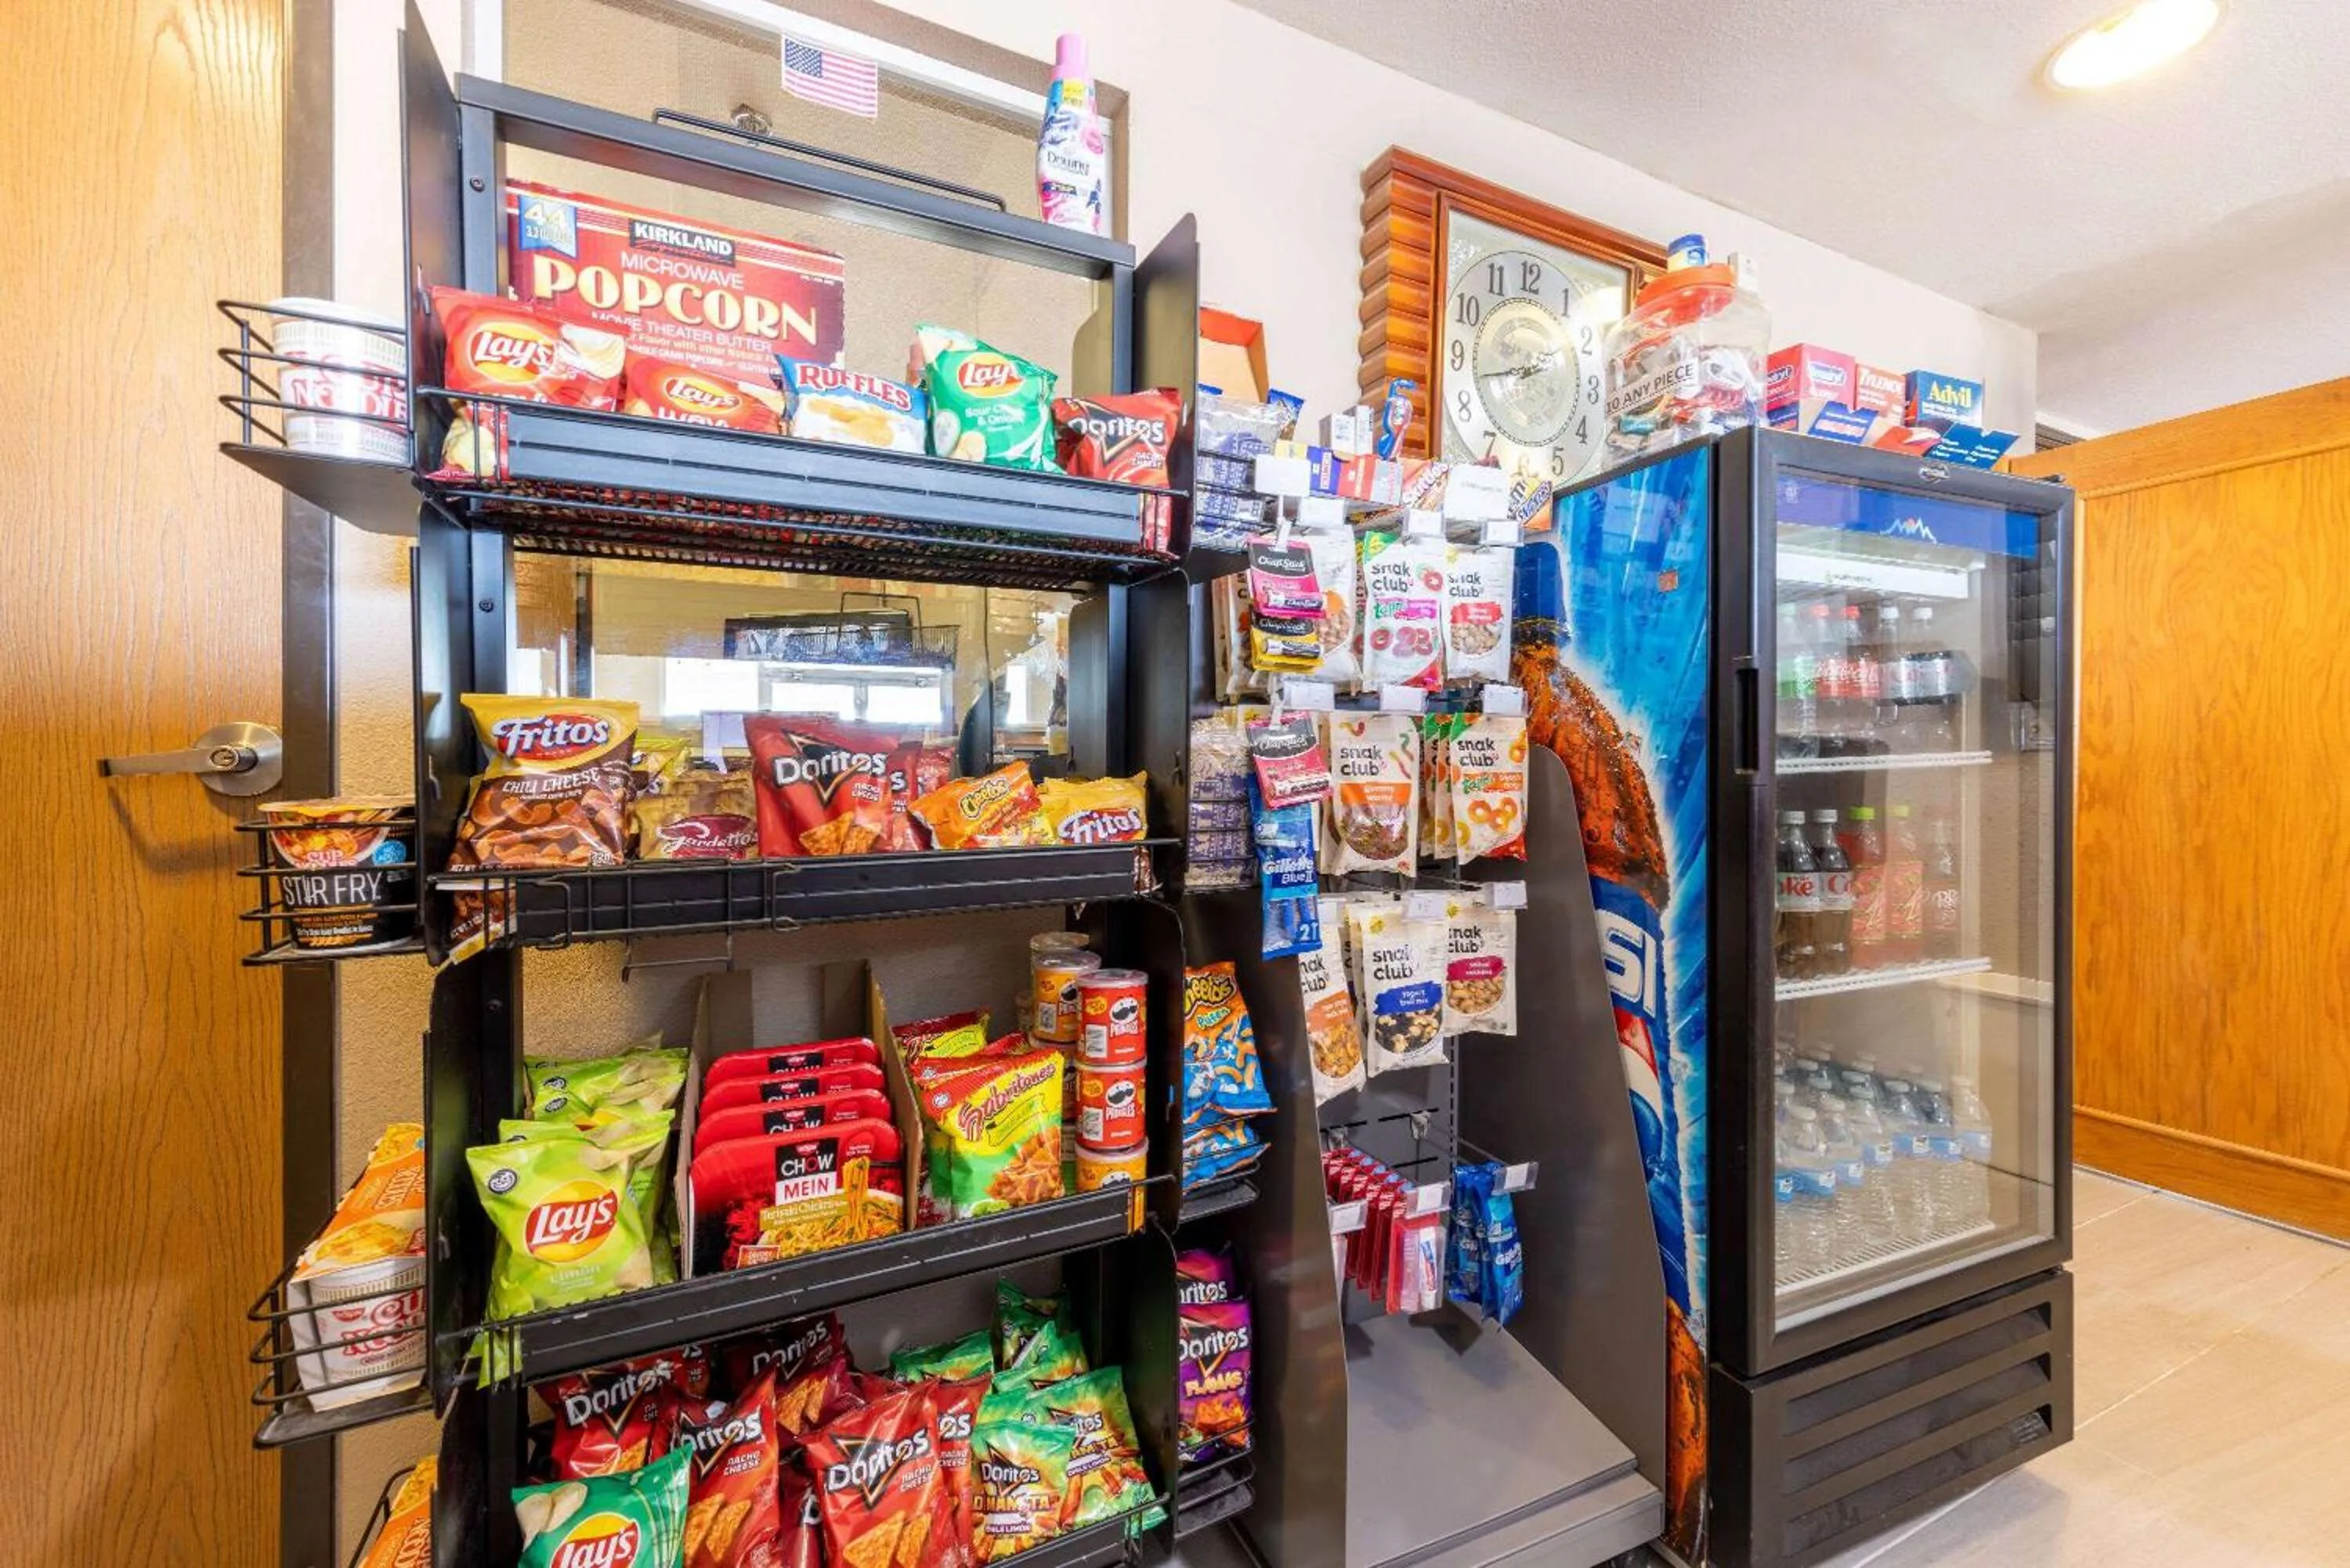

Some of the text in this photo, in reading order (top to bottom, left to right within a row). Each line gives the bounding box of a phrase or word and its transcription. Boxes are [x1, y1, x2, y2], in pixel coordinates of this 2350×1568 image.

[1047, 151, 1090, 176] Downy
[634, 222, 733, 256] KIRKLAND
[620, 251, 745, 291] MICROWAVE
[1488, 262, 1504, 297] 11
[1520, 260, 1541, 295] 12
[532, 254, 818, 346] POPCORN
[1455, 292, 1480, 327] 10
[1562, 287, 1571, 318] 1
[474, 331, 555, 368] Lay's
[645, 320, 714, 343] THEATER
[716, 332, 773, 354] BUTTER
[1581, 326, 1593, 356] 2
[1451, 338, 1464, 371] 9
[796, 360, 912, 410] RUFFLES
[963, 363, 1011, 388] Lay
[1587, 375, 1599, 405] 3
[1623, 381, 1651, 405] ANY
[1654, 363, 1694, 390] PIECE
[668, 378, 737, 408] Lay's
[1458, 389, 1472, 422] 8
[1929, 380, 1972, 408] Advil
[1068, 417, 1165, 443] Doritos
[1483, 430, 1497, 457] 7
[1575, 415, 1588, 445] 4
[1551, 446, 1564, 477] 5
[1257, 555, 1306, 569] ChapStick
[1371, 560, 1411, 576] snak
[1372, 576, 1409, 593] club
[1449, 586, 1480, 598] club
[491, 714, 609, 757] Fritos
[1457, 738, 1495, 752] snak
[1340, 746, 1383, 760] snak
[1459, 753, 1494, 767] club
[501, 767, 602, 794] CHILI CHEESE
[775, 750, 889, 787] Doritos
[1340, 761, 1379, 777] club
[960, 778, 1011, 818] Cheetos
[1058, 807, 1142, 844] Fritos
[1263, 856, 1314, 875] Gillette
[282, 871, 382, 906] STIR FRY
[1447, 940, 1480, 953] club
[1300, 953, 1326, 973] nak
[1373, 963, 1413, 981] club
[1184, 977, 1232, 1016] heetos
[957, 1063, 1057, 1141] Sabritones
[781, 1152, 834, 1176] CHOW
[784, 1177, 830, 1201] MEIN
[530, 1194, 616, 1247] Lay's
[565, 1359, 675, 1426] Doritos
[681, 1410, 764, 1451] oritos
[723, 1459, 761, 1477] CHEESE
[726, 1451, 761, 1465] NACHO
[826, 1427, 930, 1492] Doritos
[981, 1463, 1040, 1483] Doritos
[559, 1528, 636, 1568] Lay's
